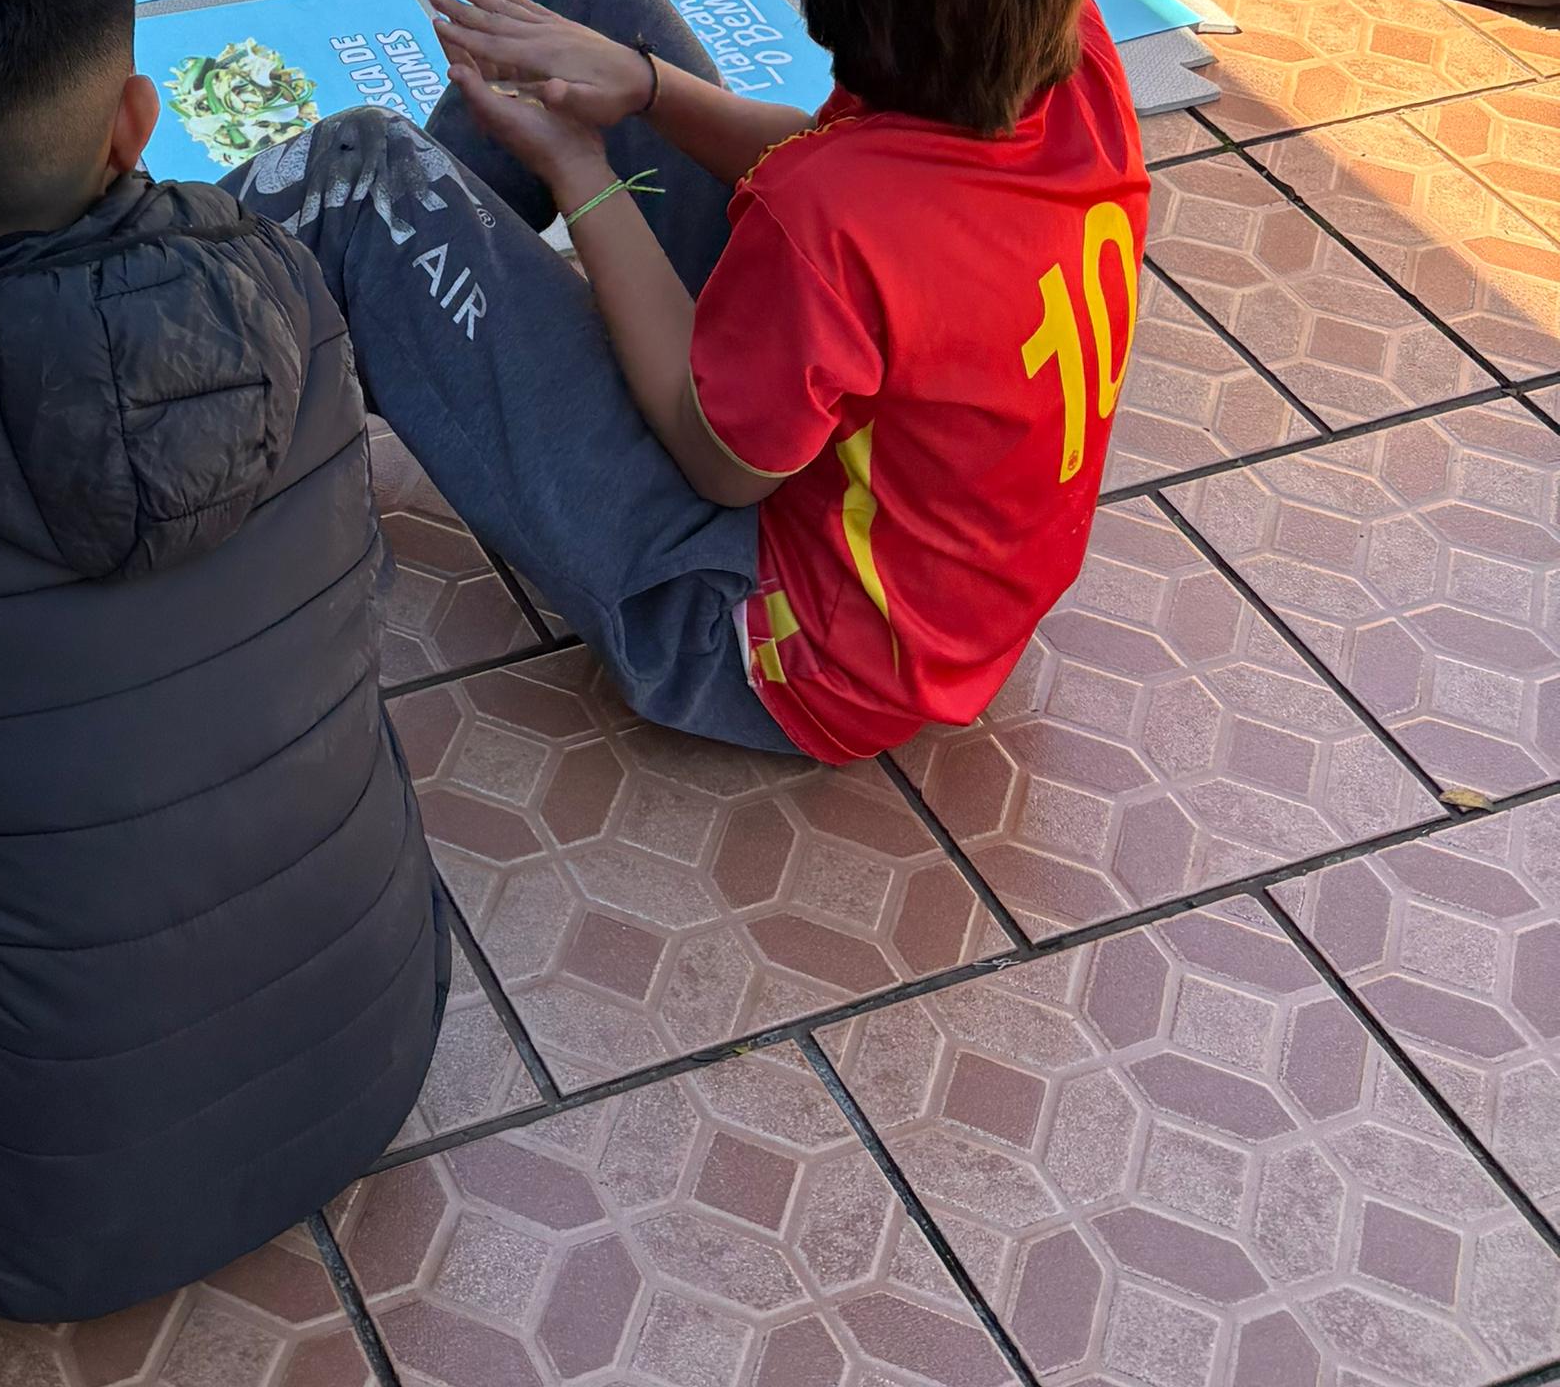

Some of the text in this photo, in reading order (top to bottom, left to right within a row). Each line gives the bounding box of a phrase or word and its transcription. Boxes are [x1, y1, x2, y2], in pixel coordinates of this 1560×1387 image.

[329, 34, 377, 65] DE
[412, 243, 487, 341] AIR
[1021, 202, 1138, 483] 10
